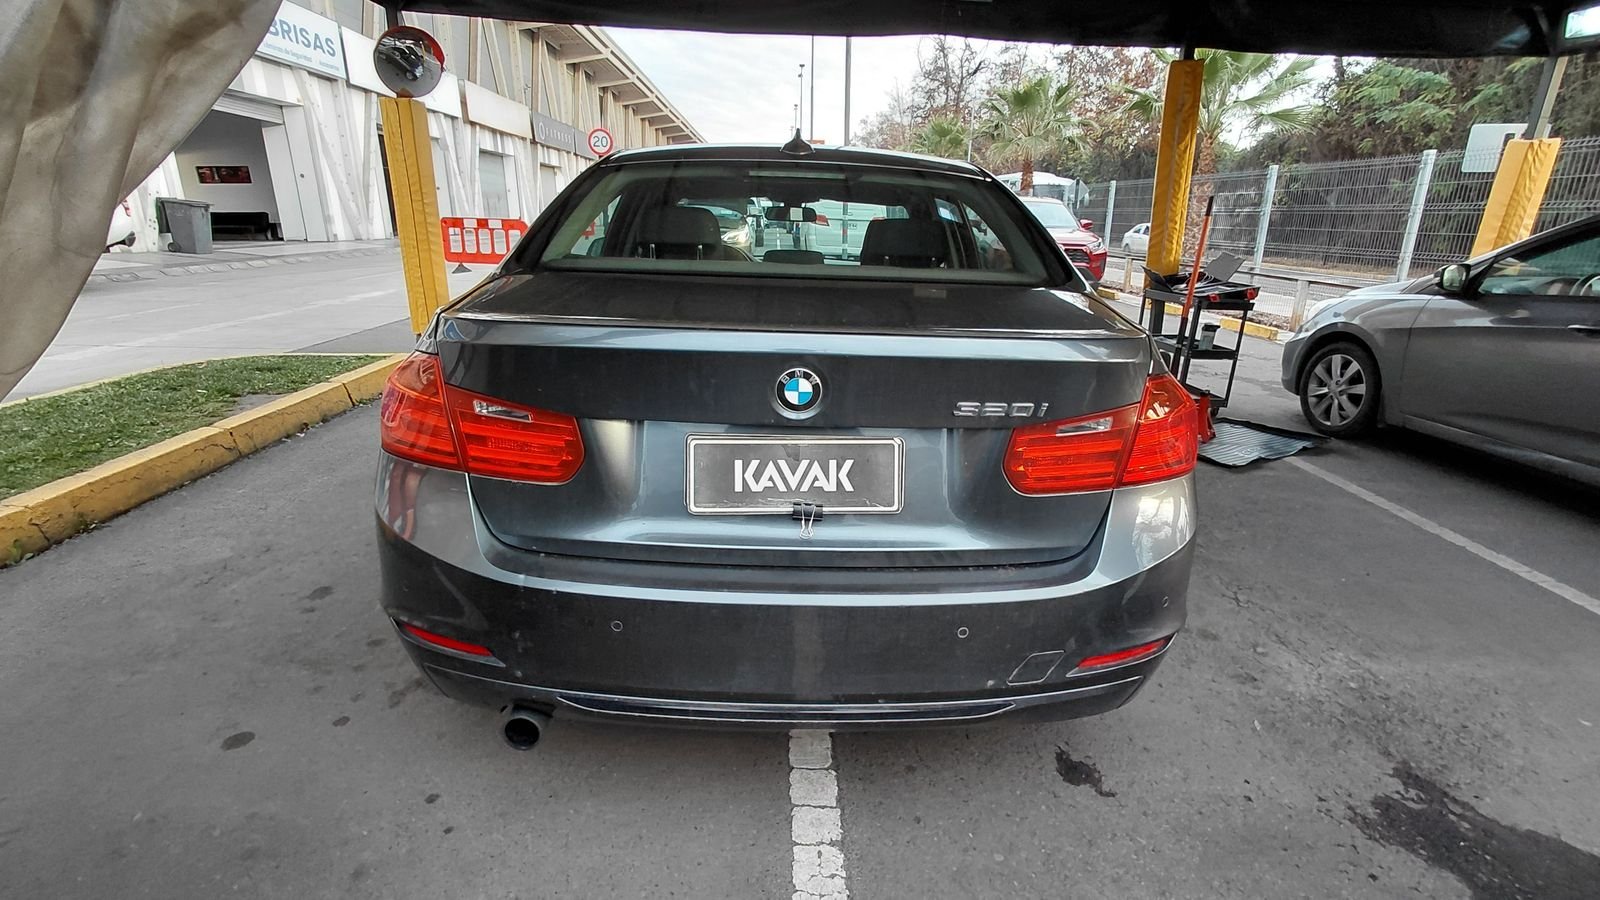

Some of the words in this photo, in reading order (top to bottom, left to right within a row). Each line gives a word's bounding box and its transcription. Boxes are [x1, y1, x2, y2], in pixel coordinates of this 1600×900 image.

[593, 136, 608, 147] 20
[780, 370, 818, 384] BMW
[952, 402, 1049, 417] 320i
[734, 459, 854, 492] KAVAK
